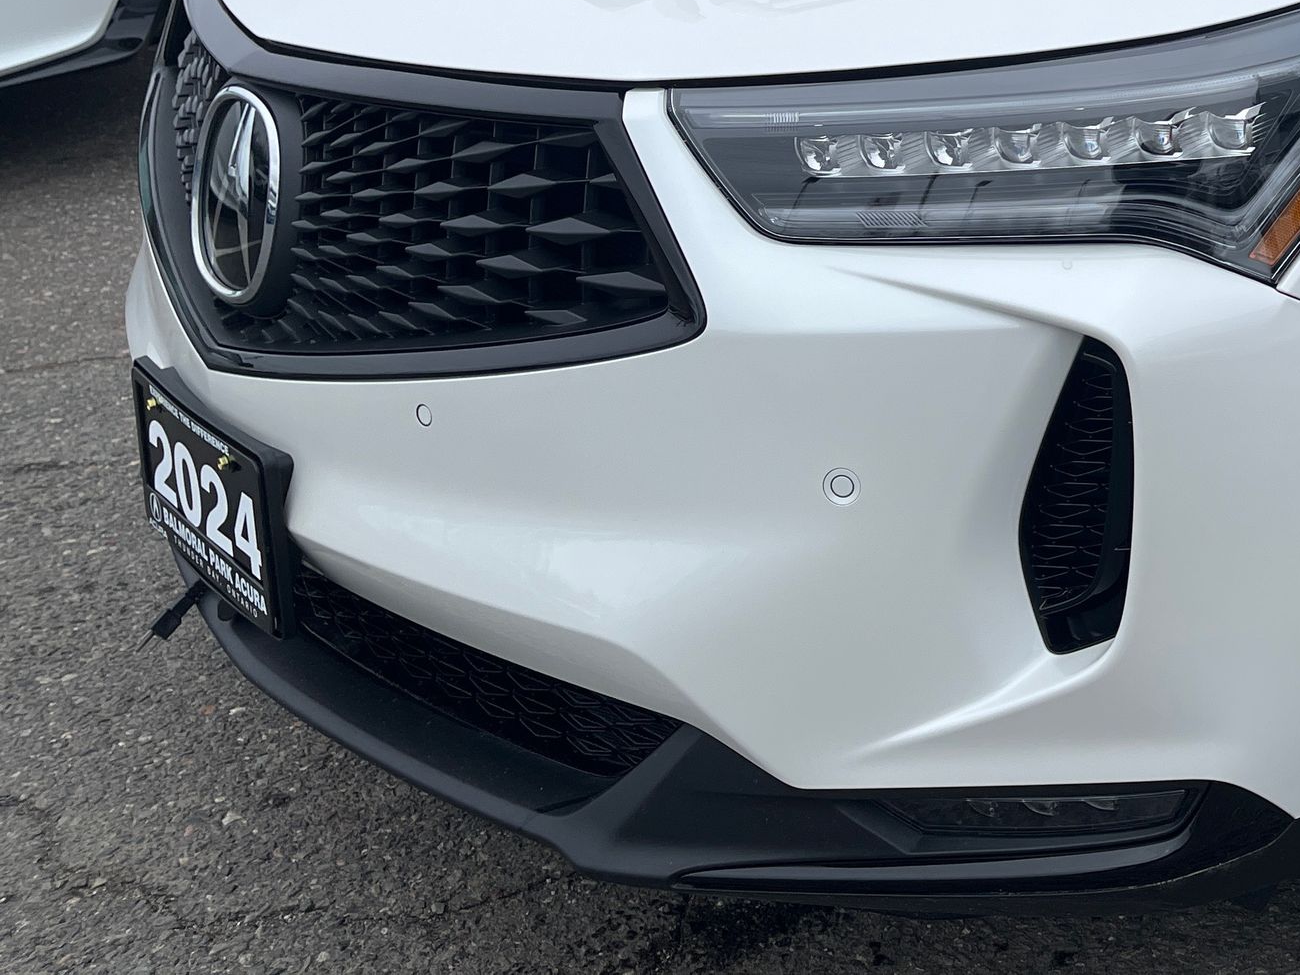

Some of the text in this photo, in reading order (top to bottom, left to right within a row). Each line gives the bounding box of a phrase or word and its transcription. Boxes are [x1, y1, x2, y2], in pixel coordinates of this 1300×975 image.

[149, 420, 262, 580] 2024
[162, 507, 267, 616] BALMORAL PARK ACURA
